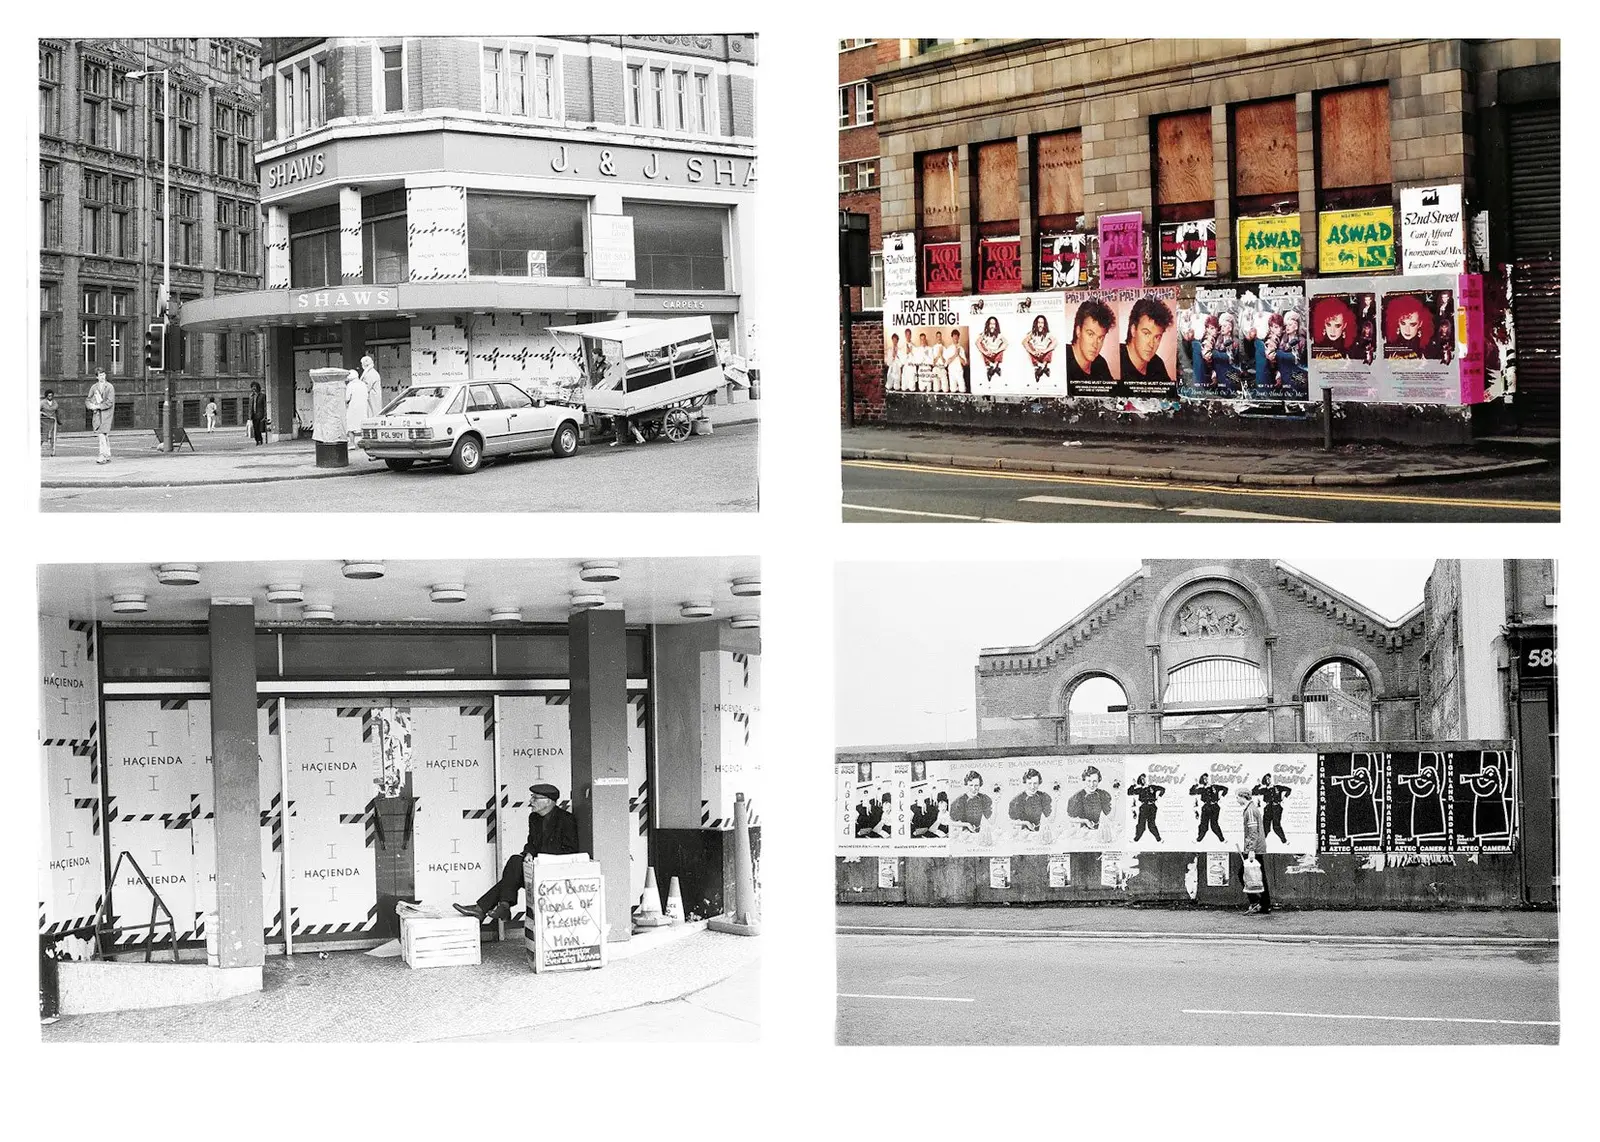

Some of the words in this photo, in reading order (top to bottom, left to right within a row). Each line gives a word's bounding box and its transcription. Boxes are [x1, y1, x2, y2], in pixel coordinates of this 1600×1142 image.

[552, 146, 578, 173] J.
[599, 149, 617, 176] &
[643, 153, 670, 180] J.
[268, 152, 326, 189] SHAWS
[1404, 211, 1431, 226] 52nd
[1430, 209, 1460, 224] Street
[1245, 229, 1303, 250] ASWAD
[1326, 222, 1392, 245] ASWAD
[986, 265, 1022, 280] GANG
[1106, 261, 1137, 272] APOLLO
[931, 268, 962, 282] GANG
[298, 290, 391, 308] SHAWS
[663, 299, 706, 309] CARPETS
[928, 313, 936, 326] IT
[938, 312, 960, 326] BIG!
[43, 676, 84, 689] HAÇIENDA
[513, 747, 564, 759] HAÇIENDA
[123, 756, 183, 768] HAÇIENDA
[301, 761, 357, 773] HAÇIENDA
[426, 759, 479, 770] HAÇIENDA
[1008, 760, 1064, 768] BLANCMANGE
[1067, 757, 1124, 766] BLANCMANGE
[49, 857, 91, 870] HAÇIENDA
[428, 862, 482, 874] HAÇIENDA
[304, 868, 360, 880] HAÇIENDA
[538, 882, 563, 897] CITY
[538, 897, 574, 913] RIDDLE
[580, 898, 594, 909] OF
[546, 915, 591, 929] FLEEING
